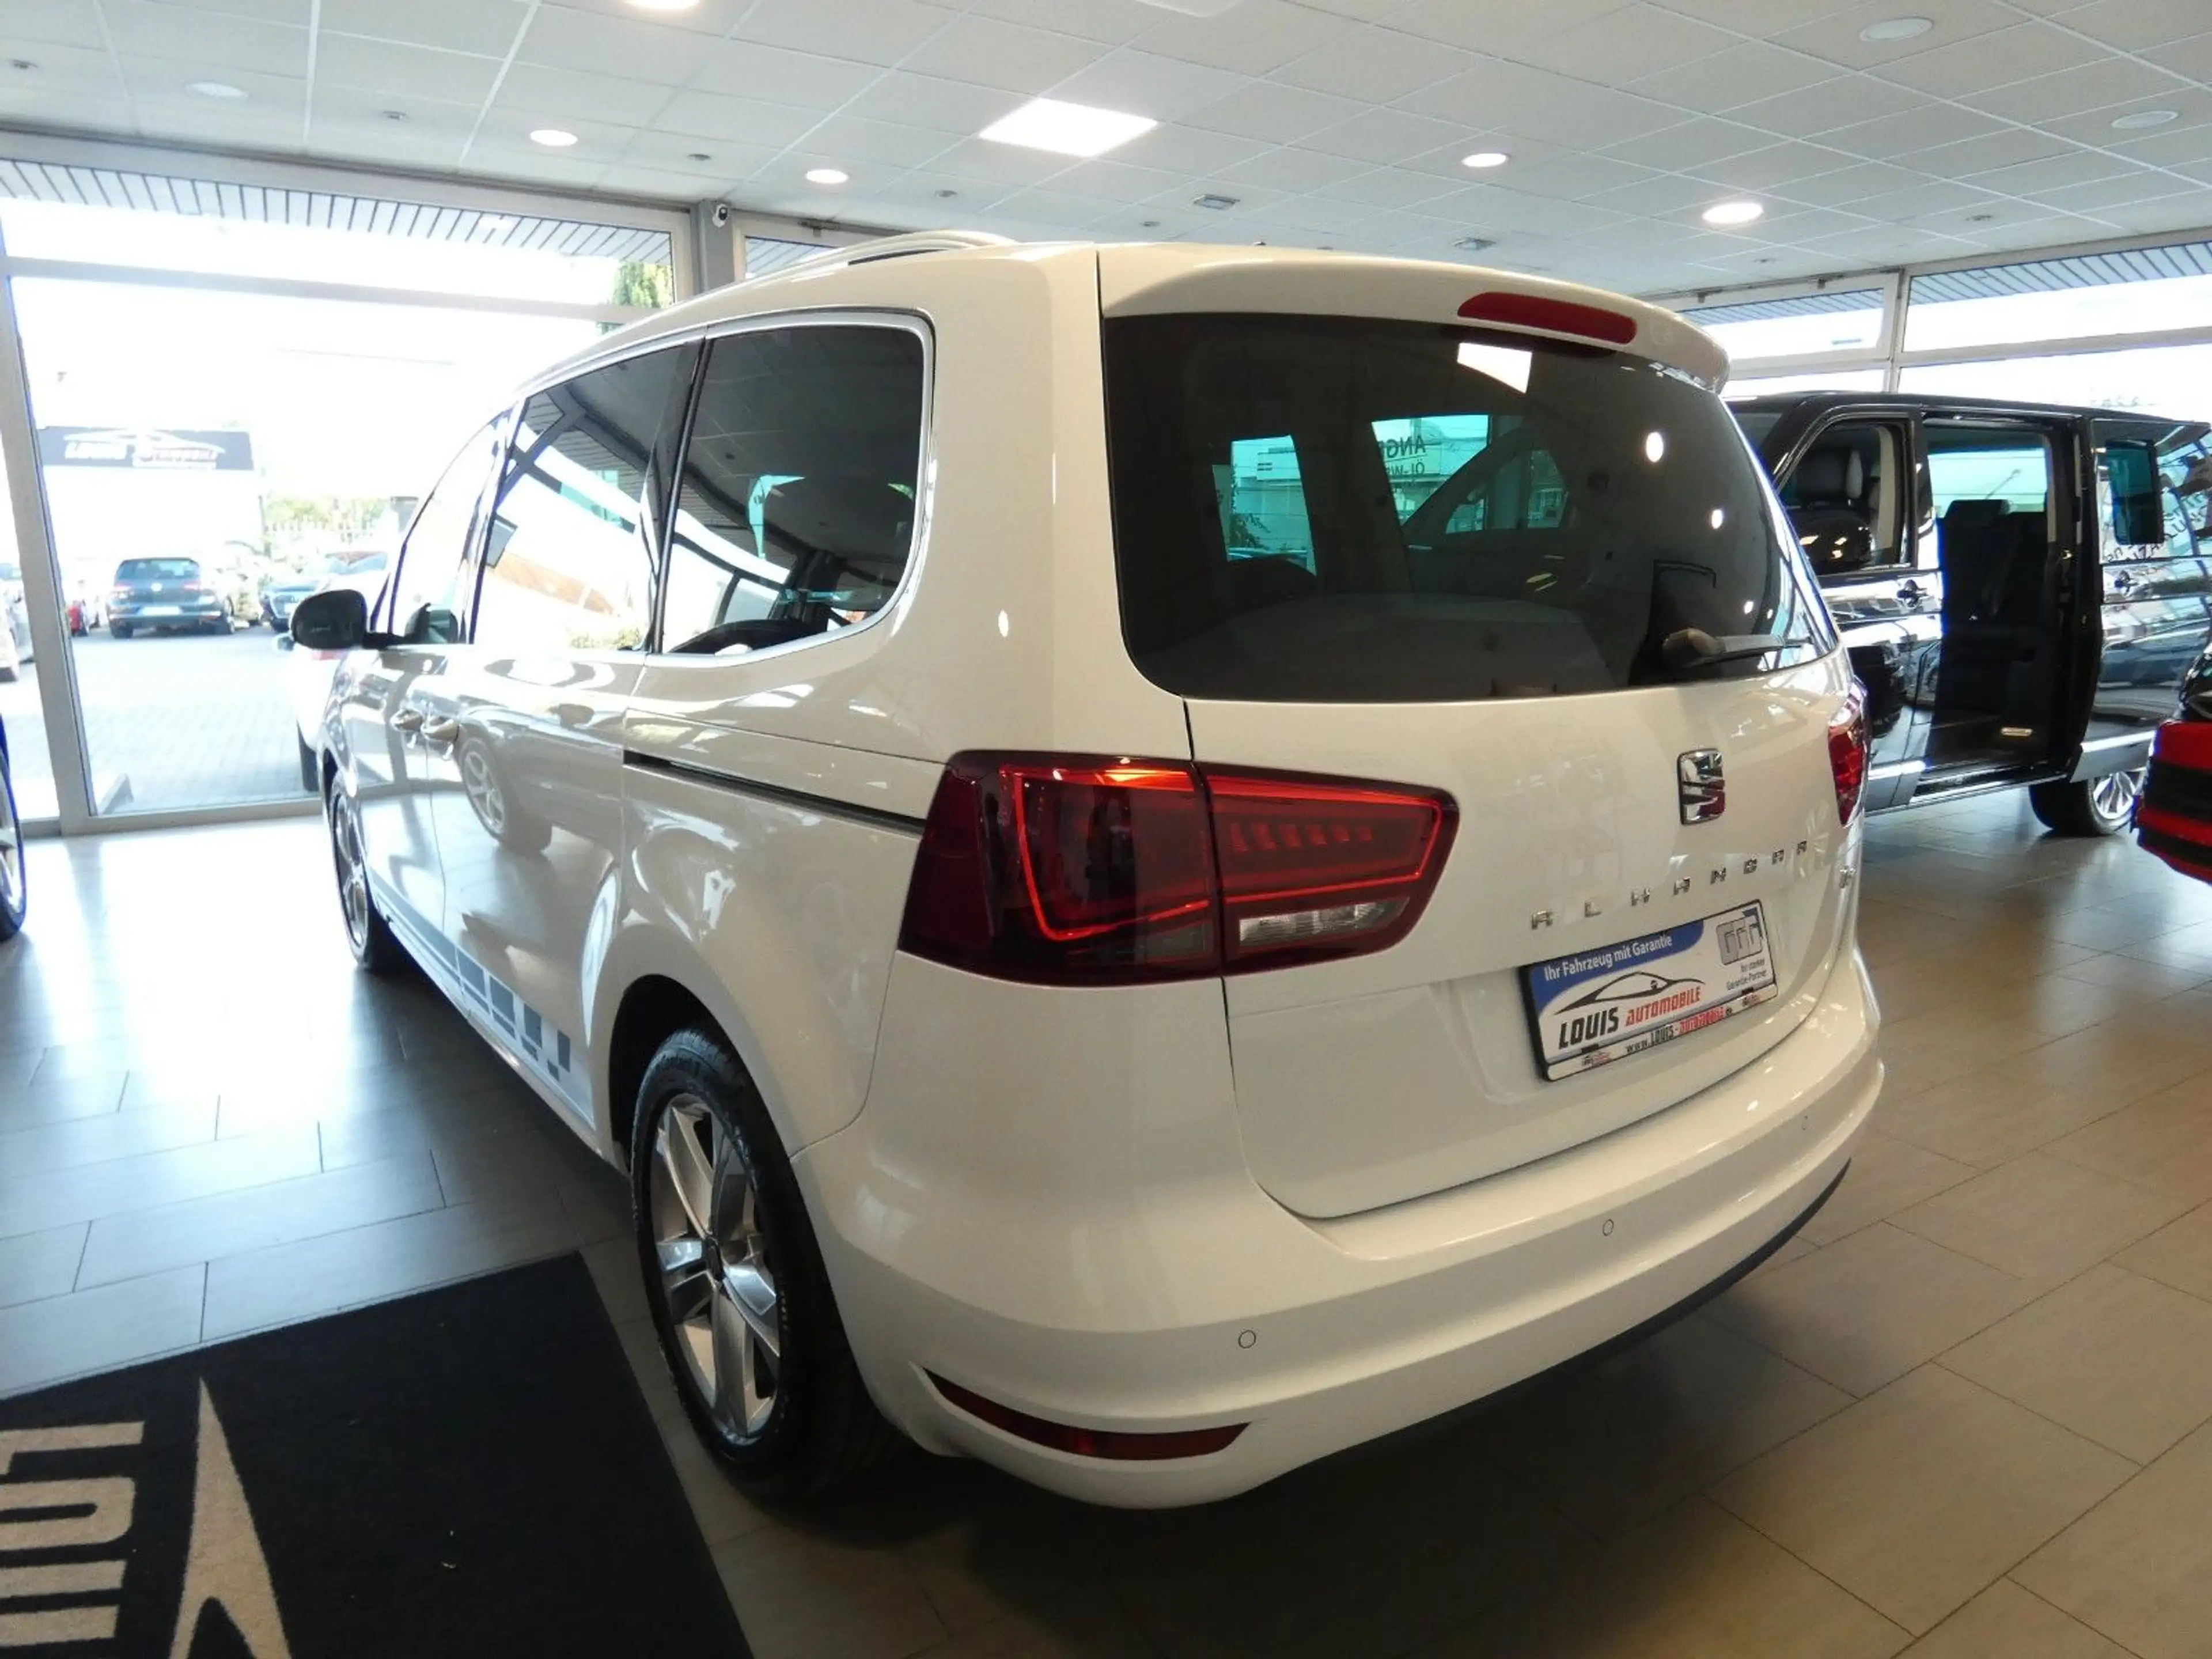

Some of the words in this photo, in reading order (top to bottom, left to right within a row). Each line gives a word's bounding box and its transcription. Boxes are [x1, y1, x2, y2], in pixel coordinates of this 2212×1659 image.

[1531, 840, 1808, 930] ALHAMBRA
[1544, 965, 1562, 981] Ihr
[1562, 952, 1613, 978] Fahrzeug
[1613, 946, 1631, 962] mit
[1632, 934, 1673, 956] Garantie
[1558, 1006, 1619, 1050] LOUIS
